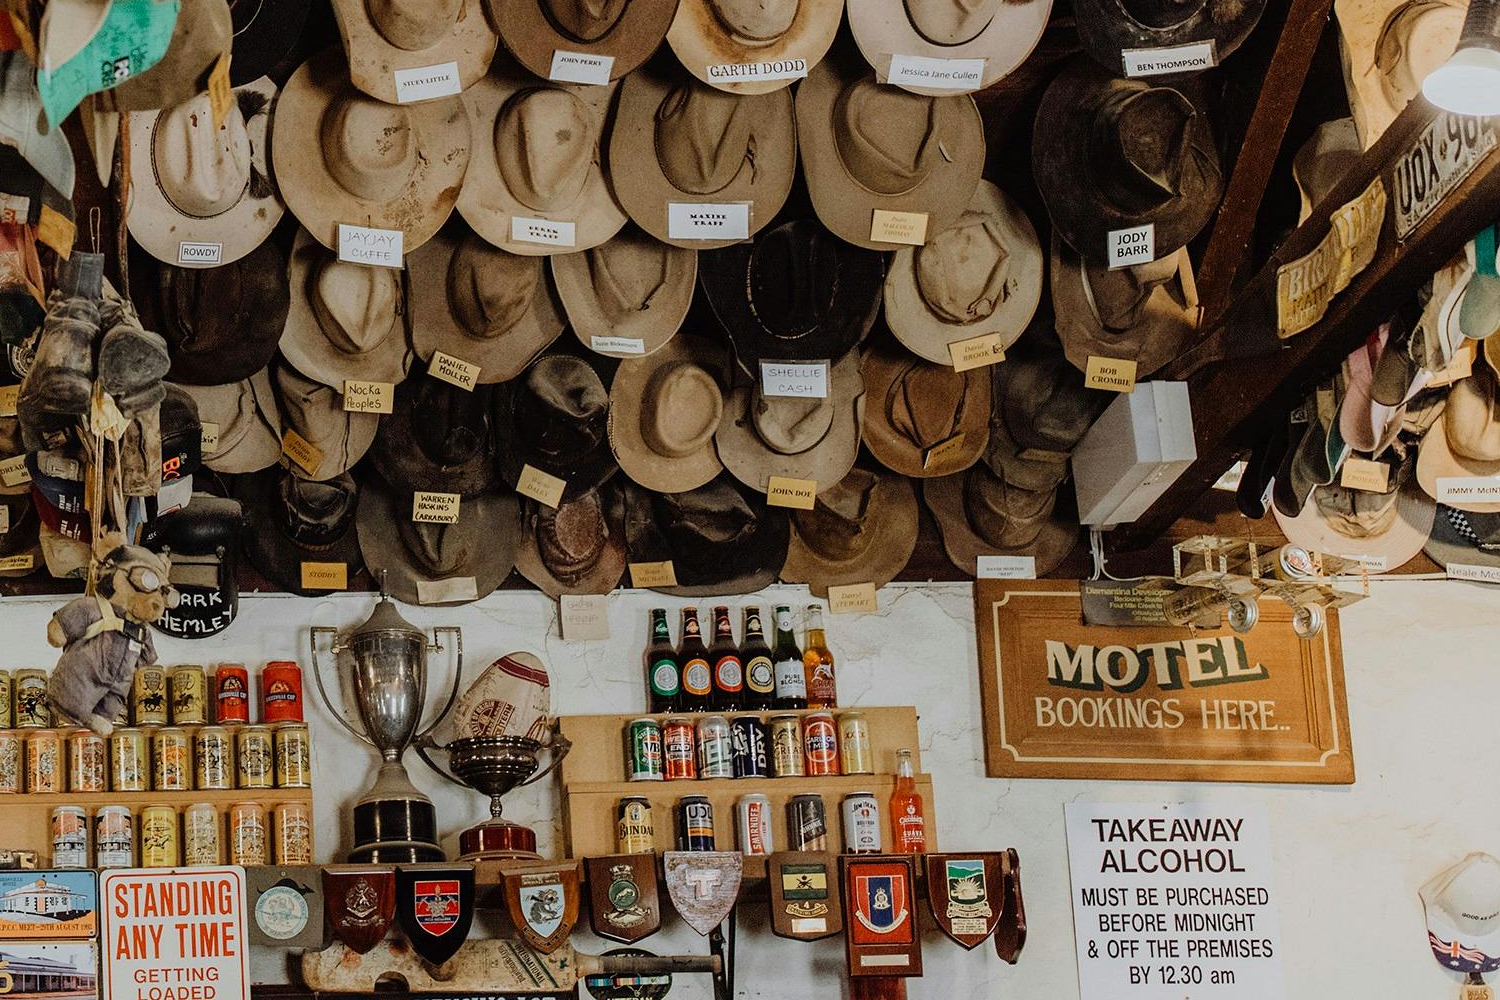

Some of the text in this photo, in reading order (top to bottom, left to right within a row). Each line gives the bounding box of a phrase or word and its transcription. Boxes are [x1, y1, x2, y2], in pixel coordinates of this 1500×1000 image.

[560, 56, 604, 67] JOHN PERRY
[1136, 57, 1206, 71] BEN THOMPSON
[709, 60, 805, 78] GARTH DODD
[900, 66, 979, 81] Jessica Jane Cullen
[424, 74, 451, 84] LITTLE
[528, 225, 559, 234] DEREK
[1117, 232, 1148, 246] JODY
[183, 246, 217, 257] ROWDY
[1117, 243, 1149, 257] BARR
[963, 351, 990, 362] BROOK
[439, 356, 469, 374] DANIEL
[1099, 367, 1117, 376] BOB
[767, 367, 821, 379] SHELLIE
[1092, 374, 1131, 387] CROMBIE
[778, 383, 813, 394] CASH
[771, 486, 789, 497] JOHN
[1446, 487, 1473, 495] JIMMY
[420, 494, 455, 505] WARREN
[418, 503, 449, 512] HASKINS
[414, 513, 459, 525] (ARRABURY)
[1448, 567, 1477, 577] Neale
[1045, 635, 1267, 691] MOTEL
[1034, 697, 1185, 730] BOOKINGS
[669, 743, 690, 752] END
[756, 728, 767, 768] DRY
[687, 805, 713, 819] UDL
[750, 806, 762, 850] SMIRNOFF
[1092, 818, 1245, 843] TAKEAWAY
[1100, 849, 1246, 874] ALCOHOL
[114, 880, 233, 919] STANDING
[1081, 888, 1269, 907] MUST BE PURCHASED
[1098, 913, 1256, 932] BEFORE MIDNIGHT
[115, 922, 236, 961] ANY TIME
[1087, 940, 1274, 958] & OFF THE PREMISES
[133, 967, 221, 985] GETTING
[1129, 966, 1236, 985] BY 12.30 am
[136, 984, 217, 1000] LOADED
